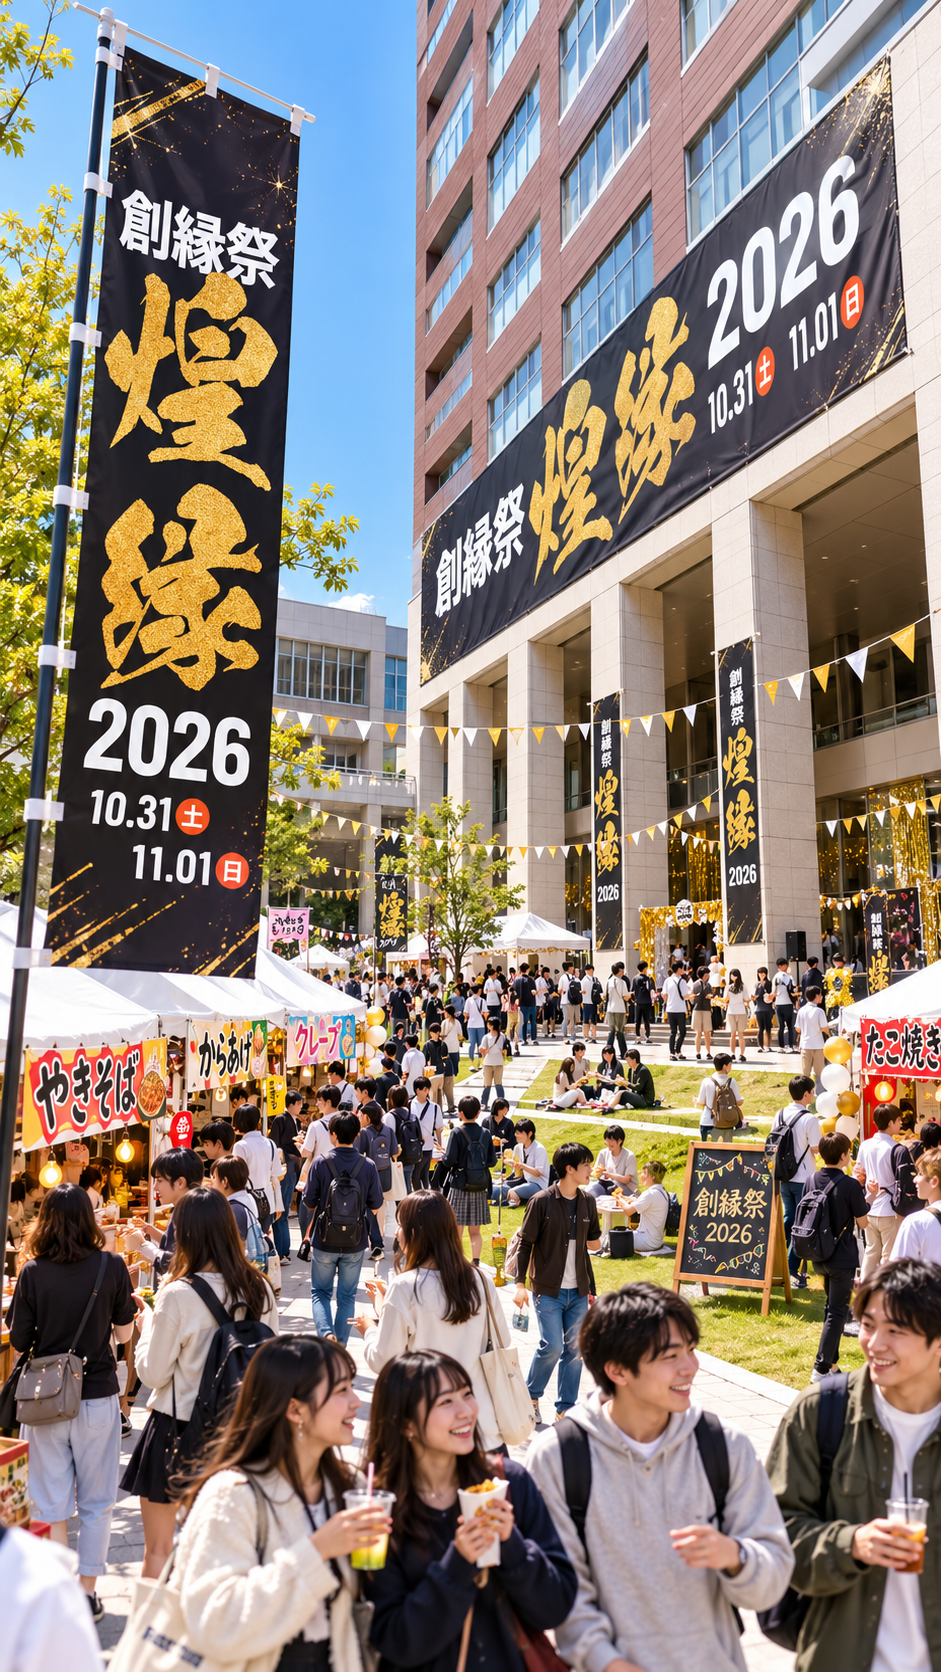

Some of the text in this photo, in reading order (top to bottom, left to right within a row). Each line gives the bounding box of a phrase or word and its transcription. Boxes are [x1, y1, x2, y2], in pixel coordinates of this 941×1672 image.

[120, 190, 279, 289] 創縁祭
[705, 154, 860, 371] 2026
[787, 285, 861, 371] 11.01 日
[707, 356, 773, 434] 10.31 土
[433, 482, 525, 618] 創縁祭
[728, 666, 745, 727] 創縁祭
[84, 698, 251, 787] 2026
[600, 718, 612, 768] 創縁祭
[91, 789, 203, 832] 10.31 土
[133, 844, 242, 886] 11.01 日
[728, 863, 757, 887] 2026
[597, 883, 620, 903] 2026
[198, 1030, 253, 1079] からあげ
[296, 1022, 341, 1059] クレープ
[866, 1023, 940, 1070] たこ焼き
[35, 1051, 140, 1132] やきそば
[693, 1187, 767, 1219] 創縁祭
[704, 1222, 752, 1244] 2026
